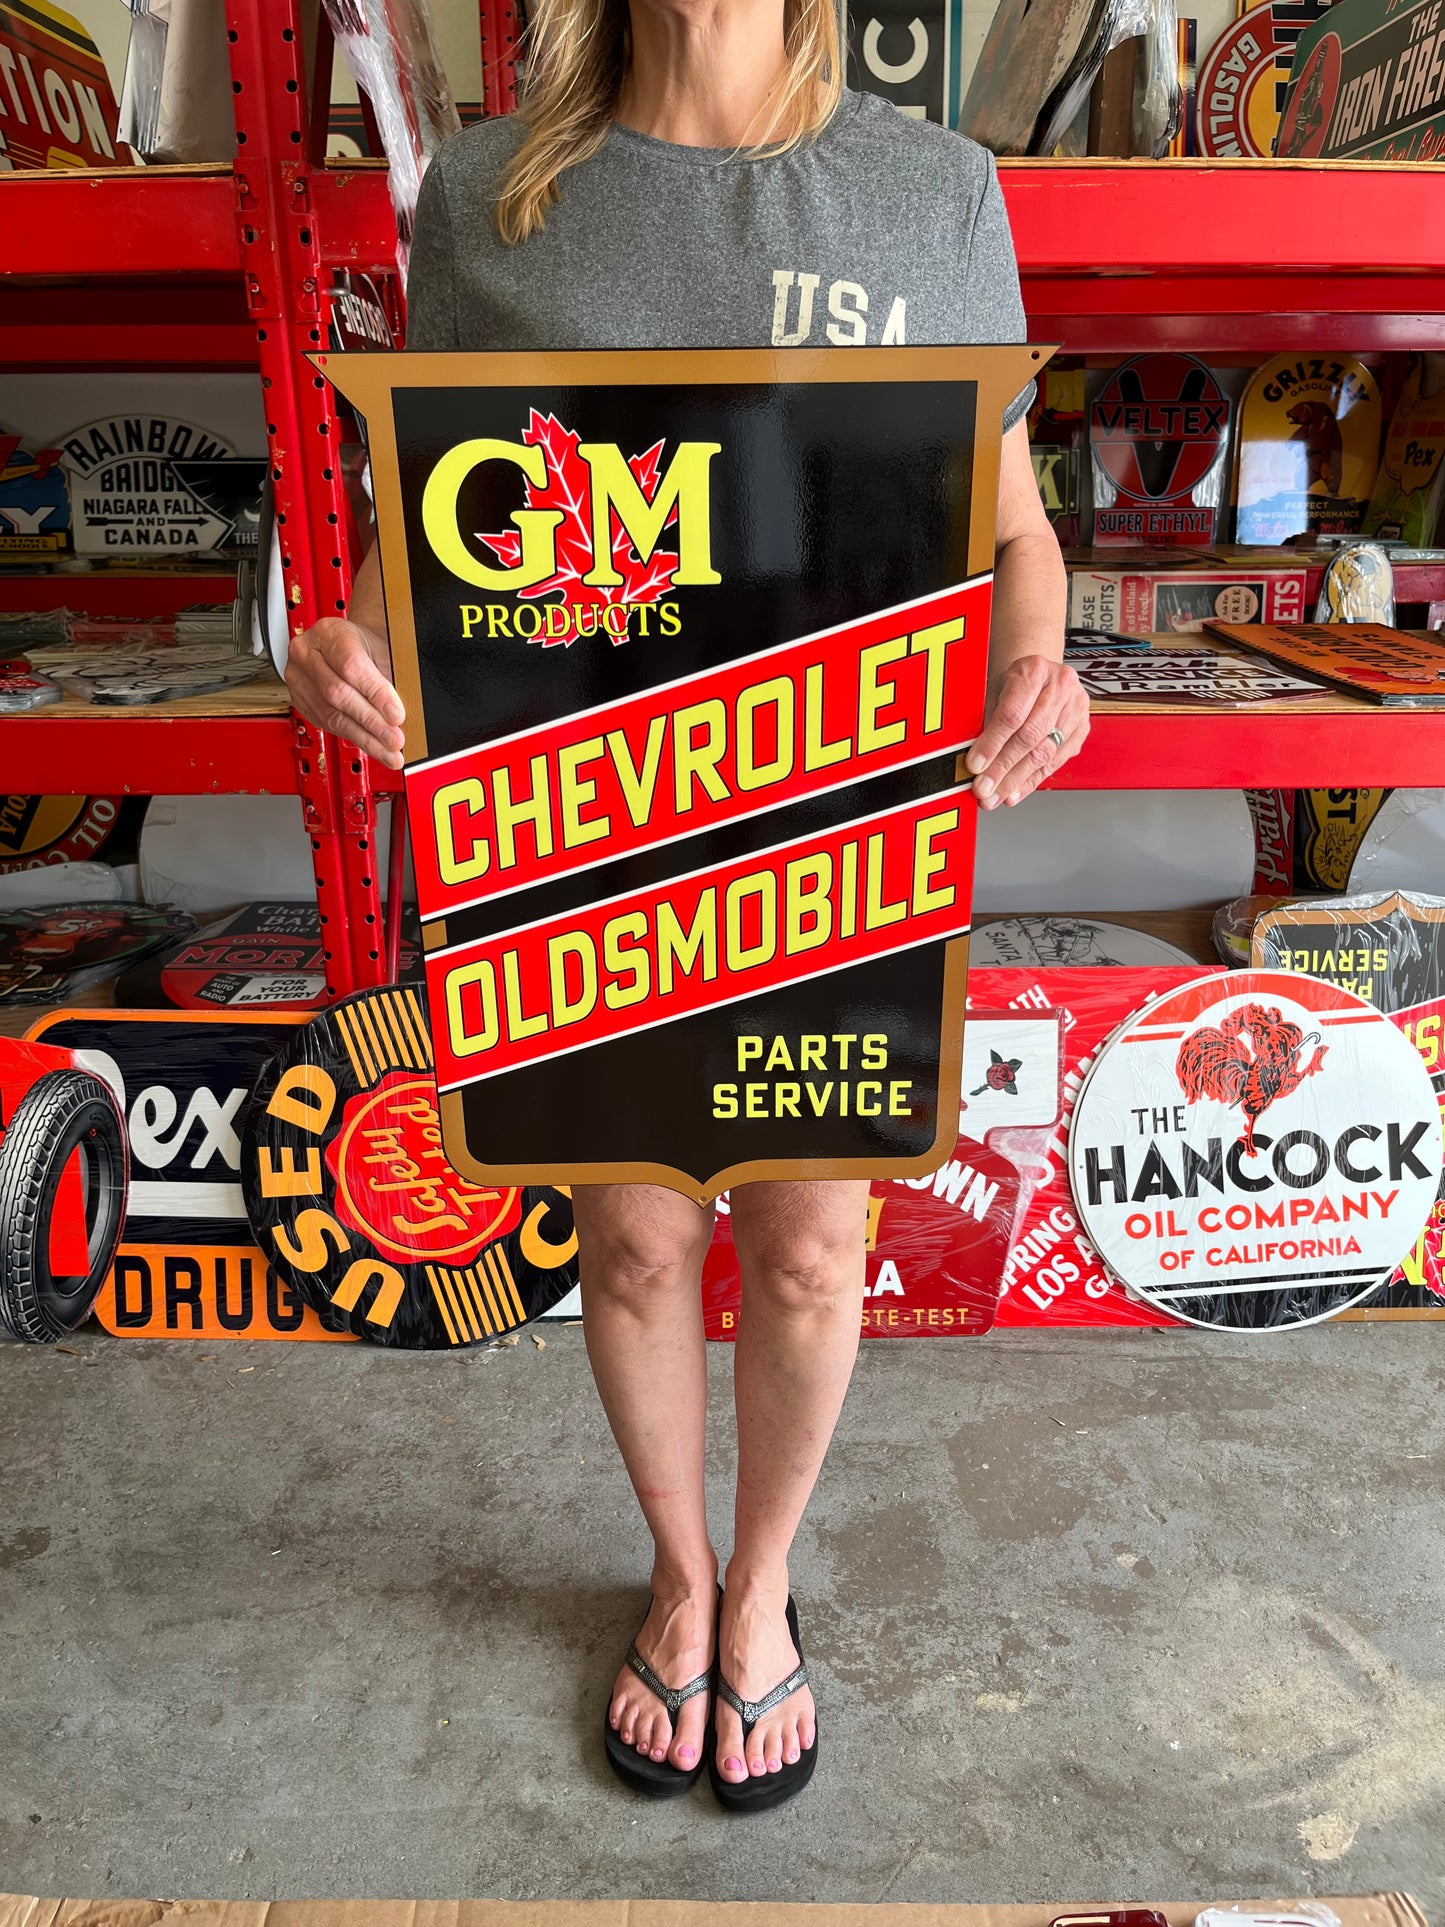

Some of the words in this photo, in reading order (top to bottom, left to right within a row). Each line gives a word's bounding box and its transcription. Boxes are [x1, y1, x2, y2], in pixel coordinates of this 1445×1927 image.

[1408, 0, 1442, 44] THE
[0, 43, 116, 160] TION
[1328, 58, 1392, 151] IRON
[771, 270, 907, 346] USA
[1263, 359, 1371, 403] GRIZZLY
[1097, 405, 1225, 438] VELTEX
[64, 419, 228, 472] RAINBOW
[101, 460, 187, 493] BRIDG
[0, 506, 57, 534] Y
[84, 499, 159, 515] NIAGARA
[136, 517, 166, 527] AND
[422, 438, 722, 591] GM
[1099, 513, 1143, 533] SUPER
[1148, 512, 1211, 533] ETHYL
[1284, 501, 1329, 511] PERFECT
[1299, 510, 1361, 520] PERFORMANCE
[105, 529, 199, 545] CANADA
[1231, 589, 1241, 621] FREE
[1273, 580, 1300, 624] ETS
[459, 602, 682, 638] PRODUCTS
[1275, 626, 1363, 647] BOND
[1329, 647, 1426, 668] GOLD
[1350, 633, 1445, 660] STAMPS
[1090, 669, 1266, 681] SERVICE
[1120, 680, 1298, 691] Rambler
[432, 616, 967, 887] CHEVROLET
[71, 799, 116, 849] OIL
[257, 905, 319, 917] Char
[444, 809, 960, 1058] OLDSMOBILE
[986, 932, 1023, 961] SANTA
[1278, 949, 1388, 972] SERVICE
[200, 990, 226, 1002] RADIO
[211, 982, 234, 991] AUTO
[239, 991, 318, 1001] BATTERY
[260, 985, 307, 993] YOUR
[270, 978, 306, 986] FOR
[737, 1034, 888, 1072] PARTS
[712, 1081, 913, 1119] SERVICE
[1131, 1105, 1187, 1135] THE
[1084, 1121, 1433, 1206] HANCOCK
[259, 1064, 405, 1328] USED
[361, 1127, 469, 1235] Safety
[1125, 1208, 1188, 1239] OIL
[1197, 1189, 1401, 1234] COMPANY
[1159, 1249, 1195, 1271] OF
[1205, 1235, 1362, 1266] CALIFORNIA
[116, 1256, 350, 1333] DRUG
[1022, 1254, 1080, 1311] LOS
